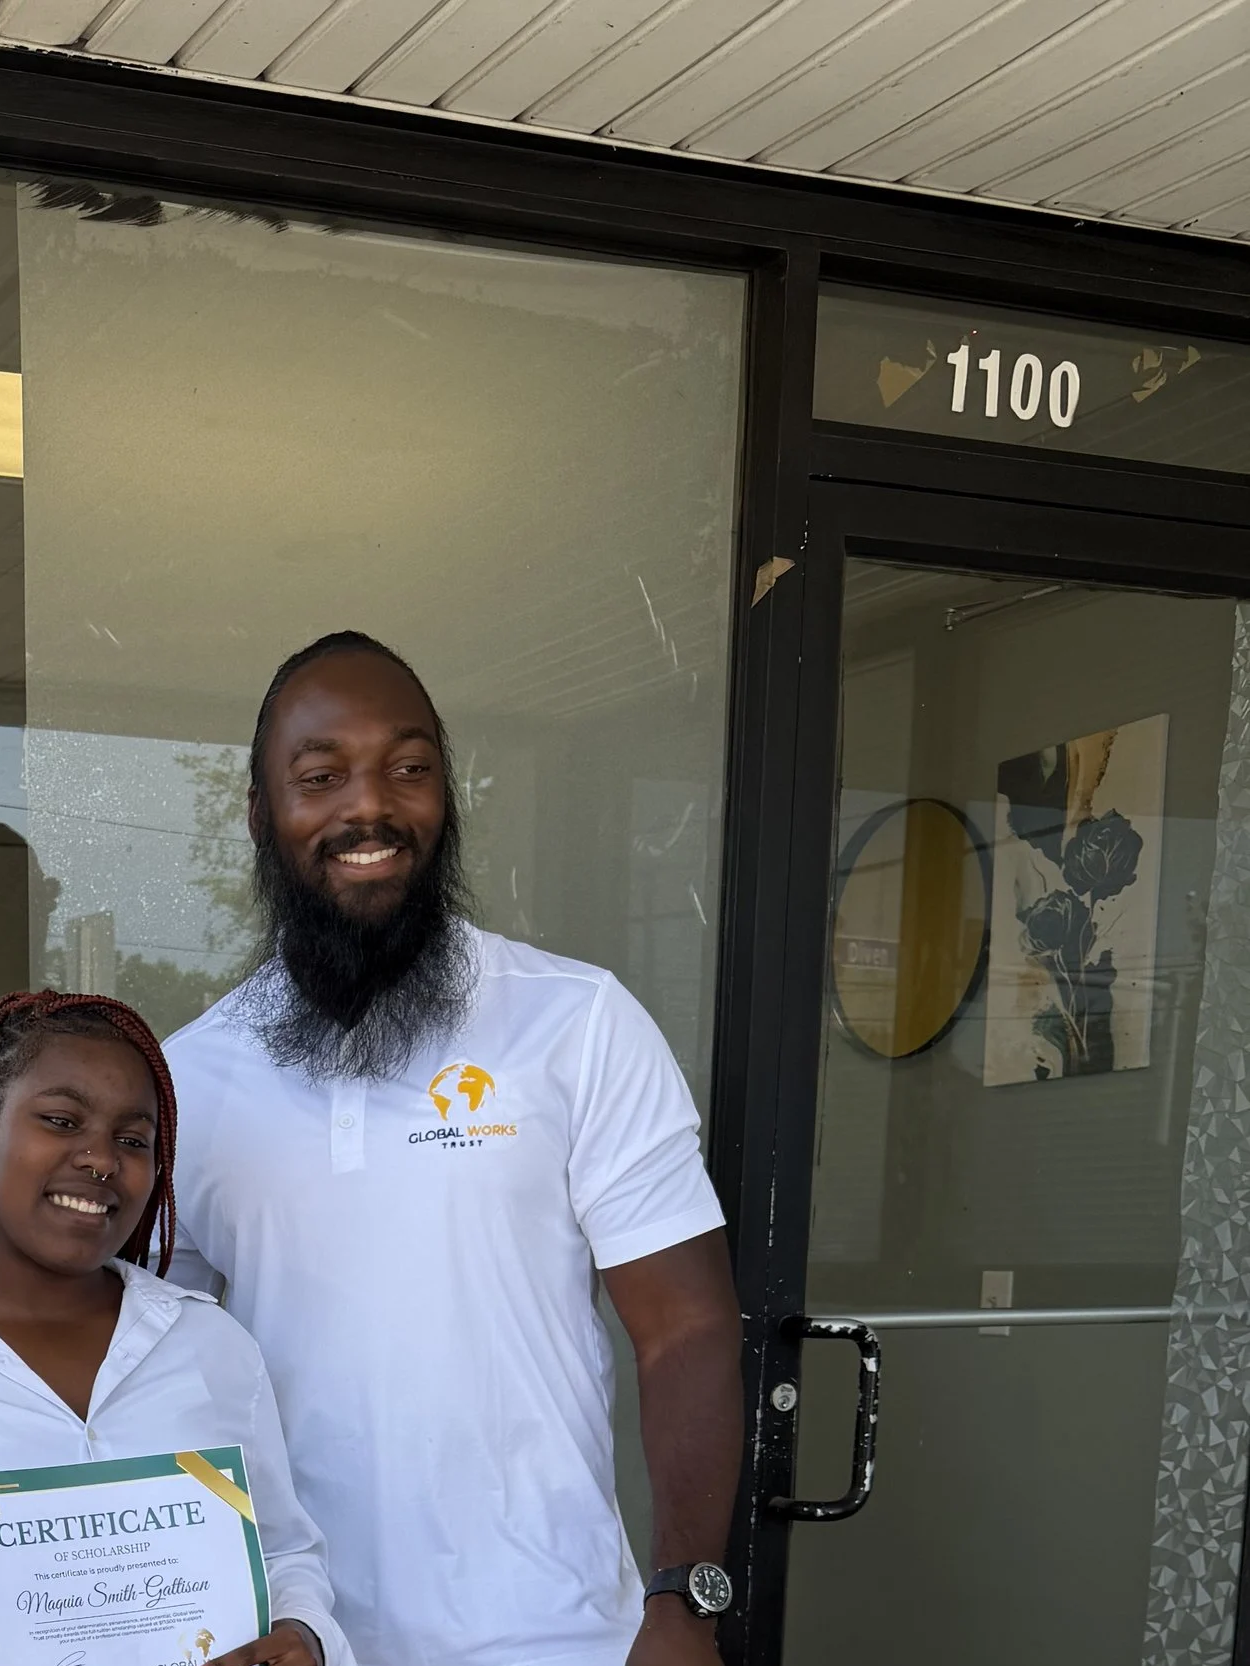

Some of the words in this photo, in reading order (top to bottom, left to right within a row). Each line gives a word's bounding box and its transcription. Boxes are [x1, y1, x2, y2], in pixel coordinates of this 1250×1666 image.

[947, 344, 1081, 428] 1100
[408, 1127, 464, 1144] GLOBAL
[466, 1124, 517, 1136] WORKS
[441, 1140, 483, 1149] TRUST
[54, 1552, 69, 1563] OF
[71, 1542, 151, 1561] SCHOLARSHIP
[34, 1573, 50, 1581] This
[50, 1570, 88, 1580] certificate
[97, 1564, 125, 1574] proudly
[127, 1559, 166, 1571] presented
[168, 1557, 179, 1565] to:
[16, 1590, 85, 1617] Maquia
